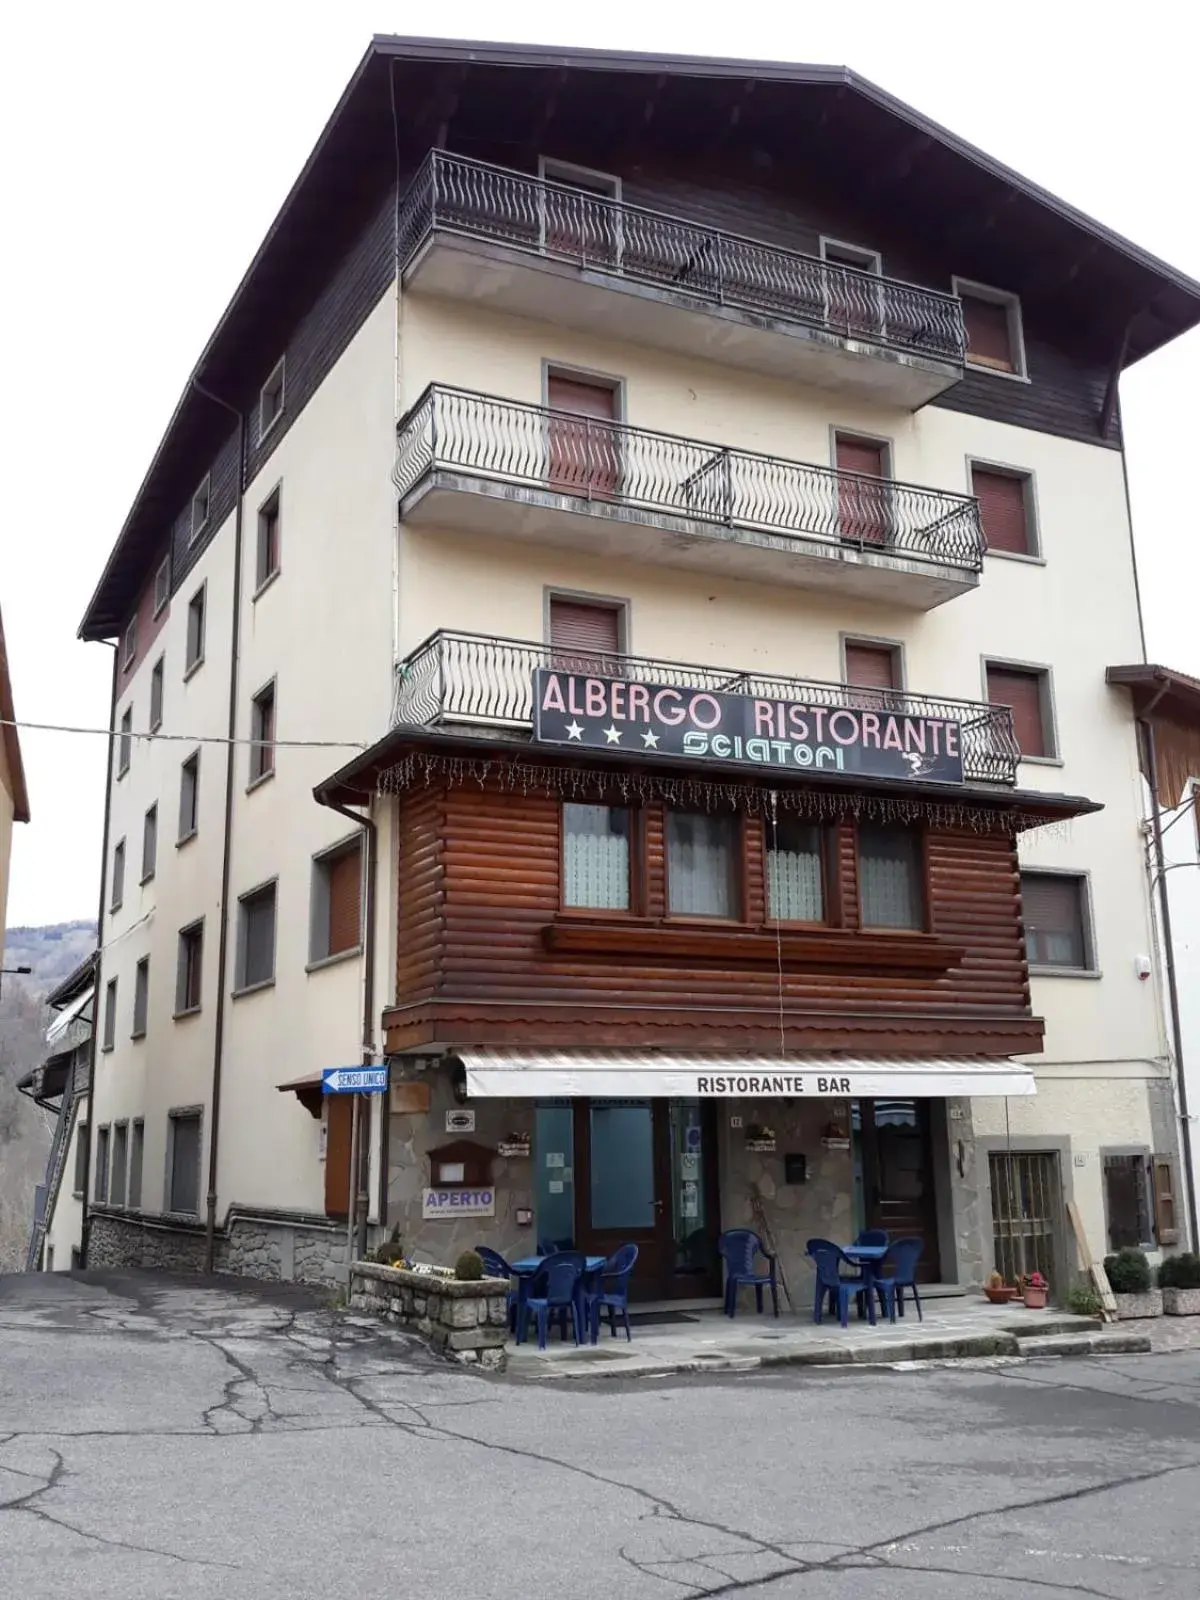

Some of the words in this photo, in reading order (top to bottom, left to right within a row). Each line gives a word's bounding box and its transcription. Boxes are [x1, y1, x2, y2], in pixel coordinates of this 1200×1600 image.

[541, 674, 722, 730] ALBERGO
[754, 699, 959, 757] RISTORANTE
[338, 1072, 361, 1087] SENSO
[363, 1071, 385, 1086] UNICO
[697, 1076, 804, 1093] RISTORANTE
[817, 1077, 851, 1093] BAR
[427, 1191, 492, 1206] APERTO
